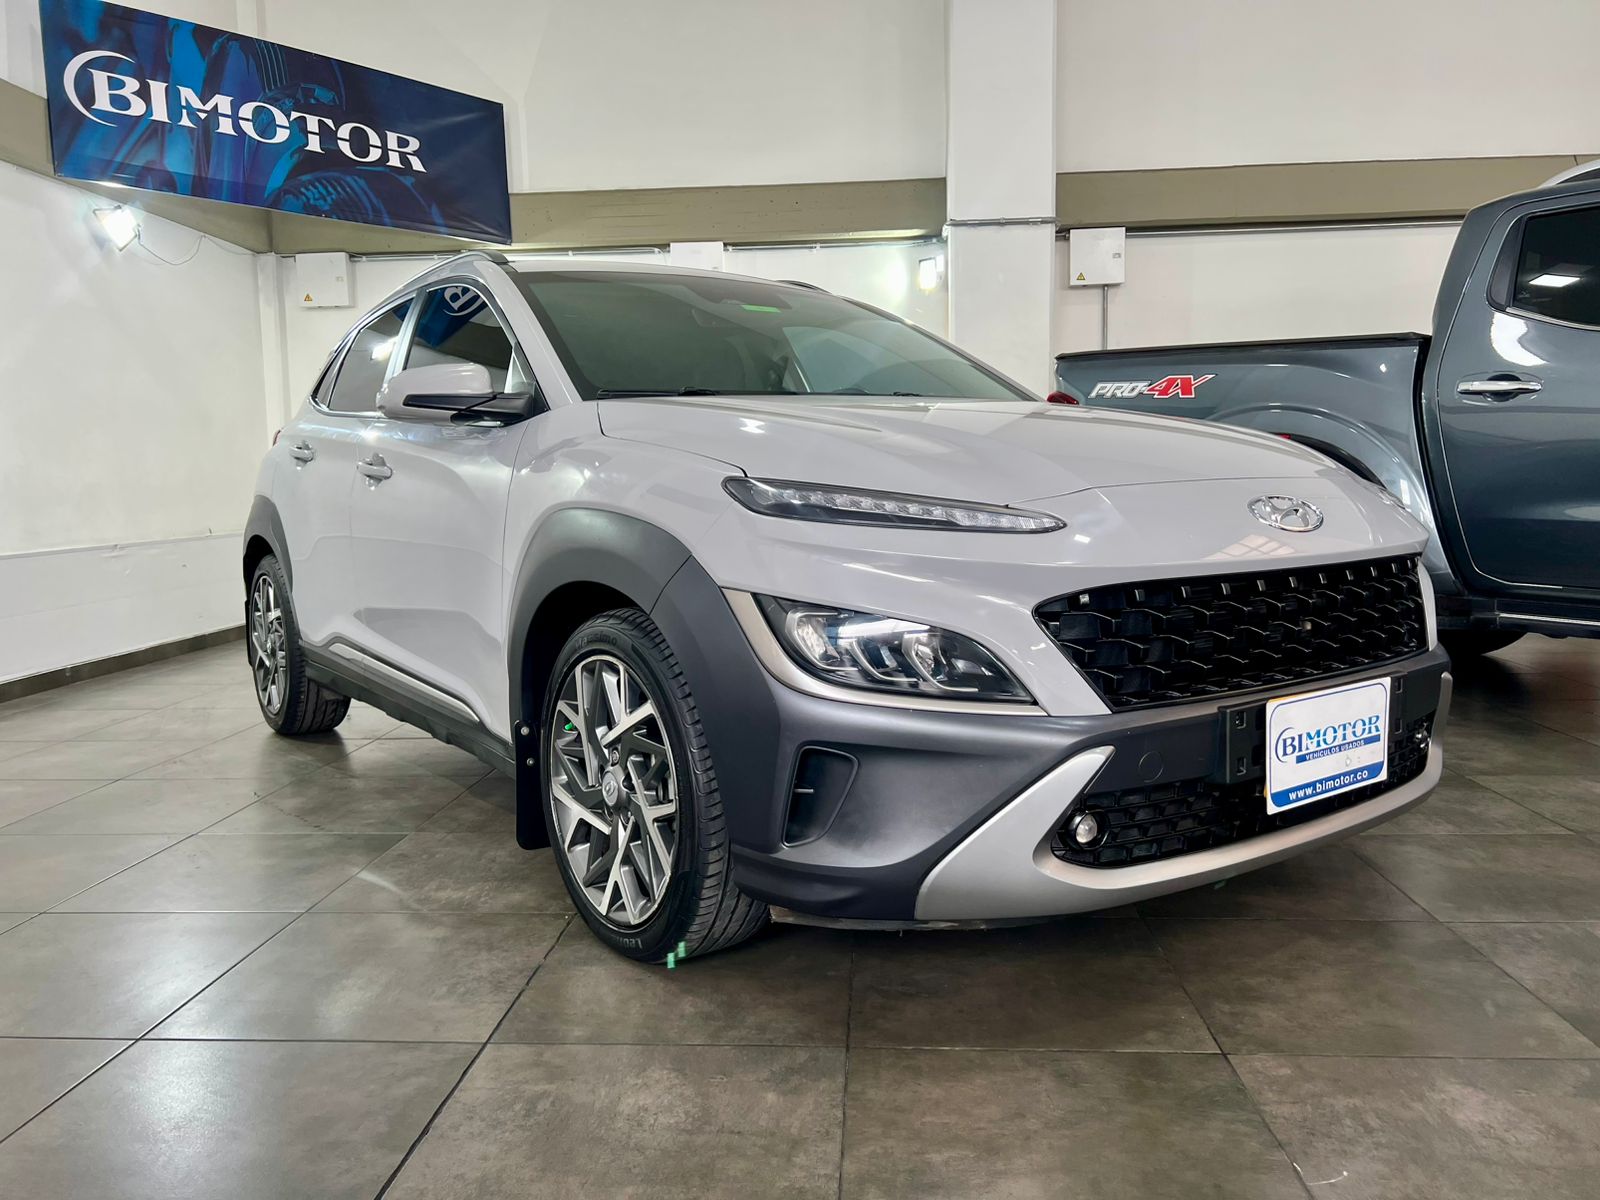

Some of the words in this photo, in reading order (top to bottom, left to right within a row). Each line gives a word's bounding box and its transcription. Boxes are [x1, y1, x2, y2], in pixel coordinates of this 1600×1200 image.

[86, 67, 428, 173] BIMOTOR
[1087, 374, 1218, 399] PRO-4X
[1281, 714, 1381, 758] BIMOTOR
[1340, 739, 1365, 753] USADOS
[1288, 769, 1369, 801] www.bimotor.co
